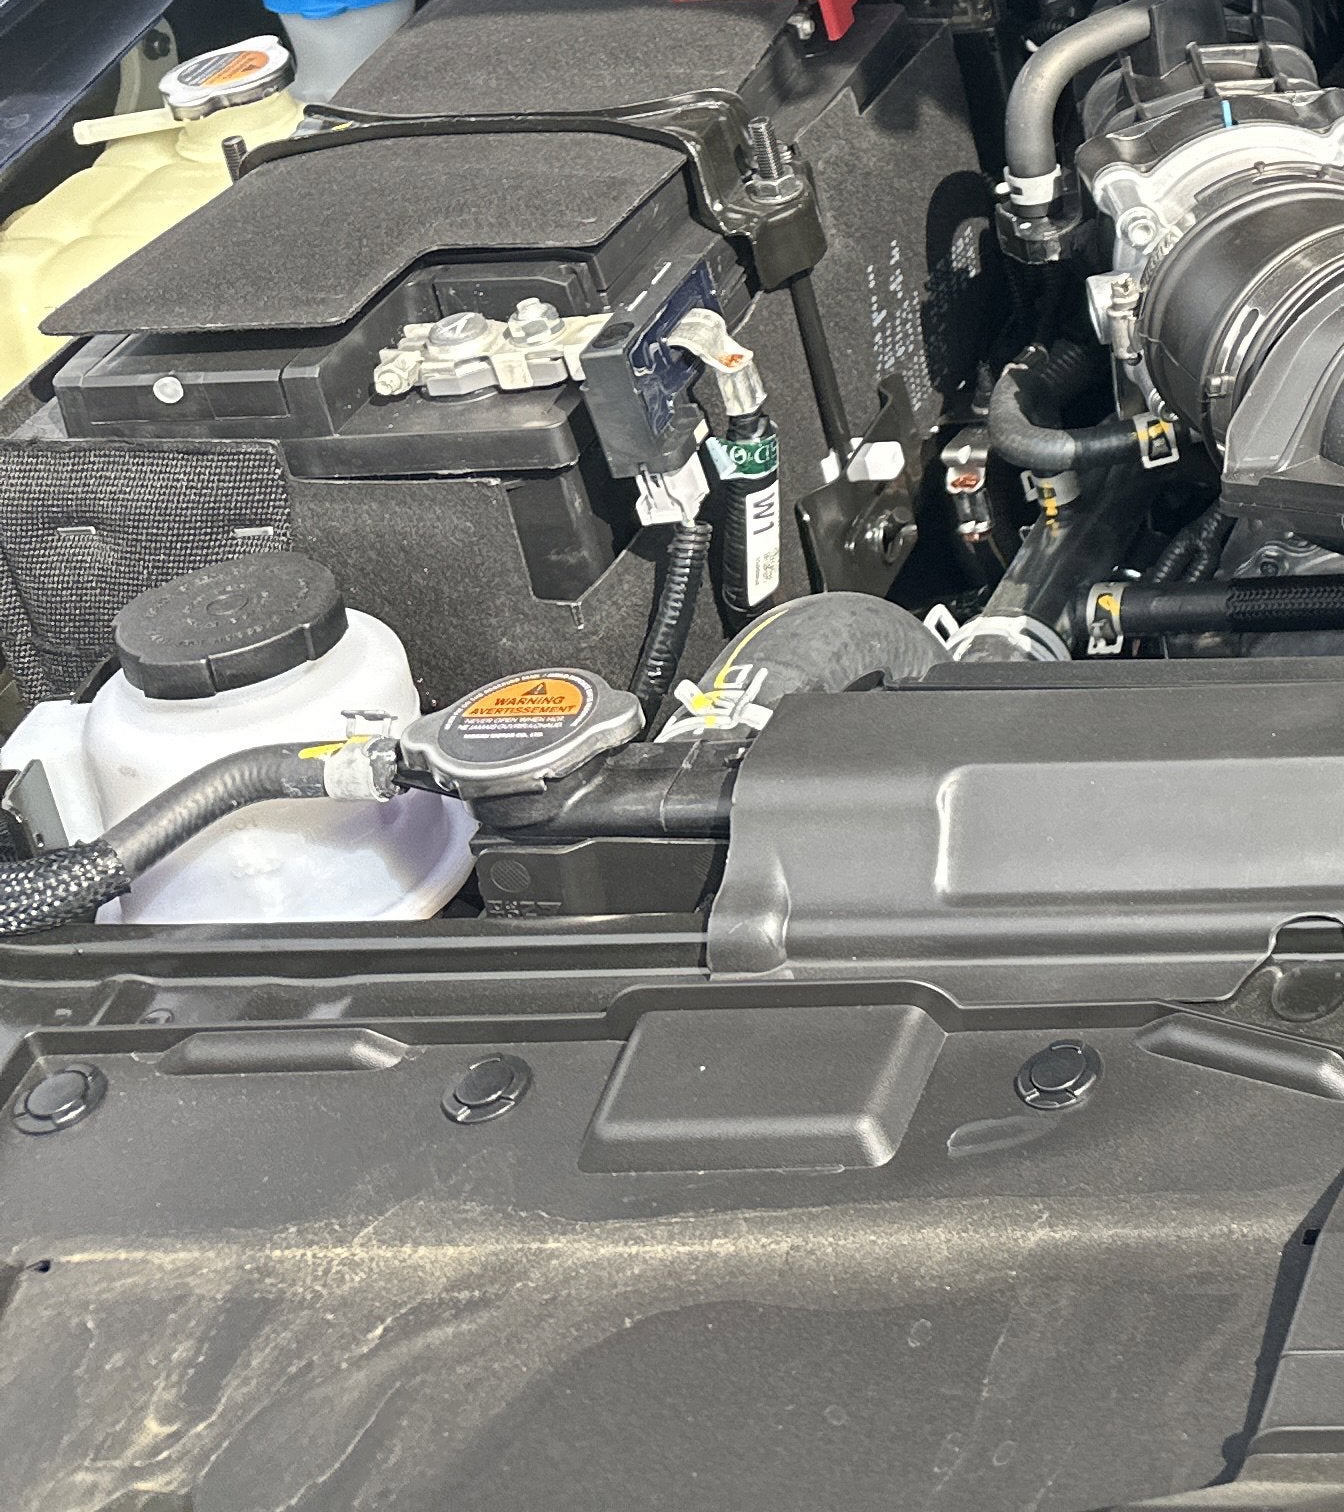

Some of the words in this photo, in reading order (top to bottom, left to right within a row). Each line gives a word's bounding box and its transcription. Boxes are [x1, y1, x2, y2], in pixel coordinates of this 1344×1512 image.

[753, 492, 775, 536] W1
[494, 696, 566, 706] WARNING
[470, 705, 576, 715] AVERTISSEMENT
